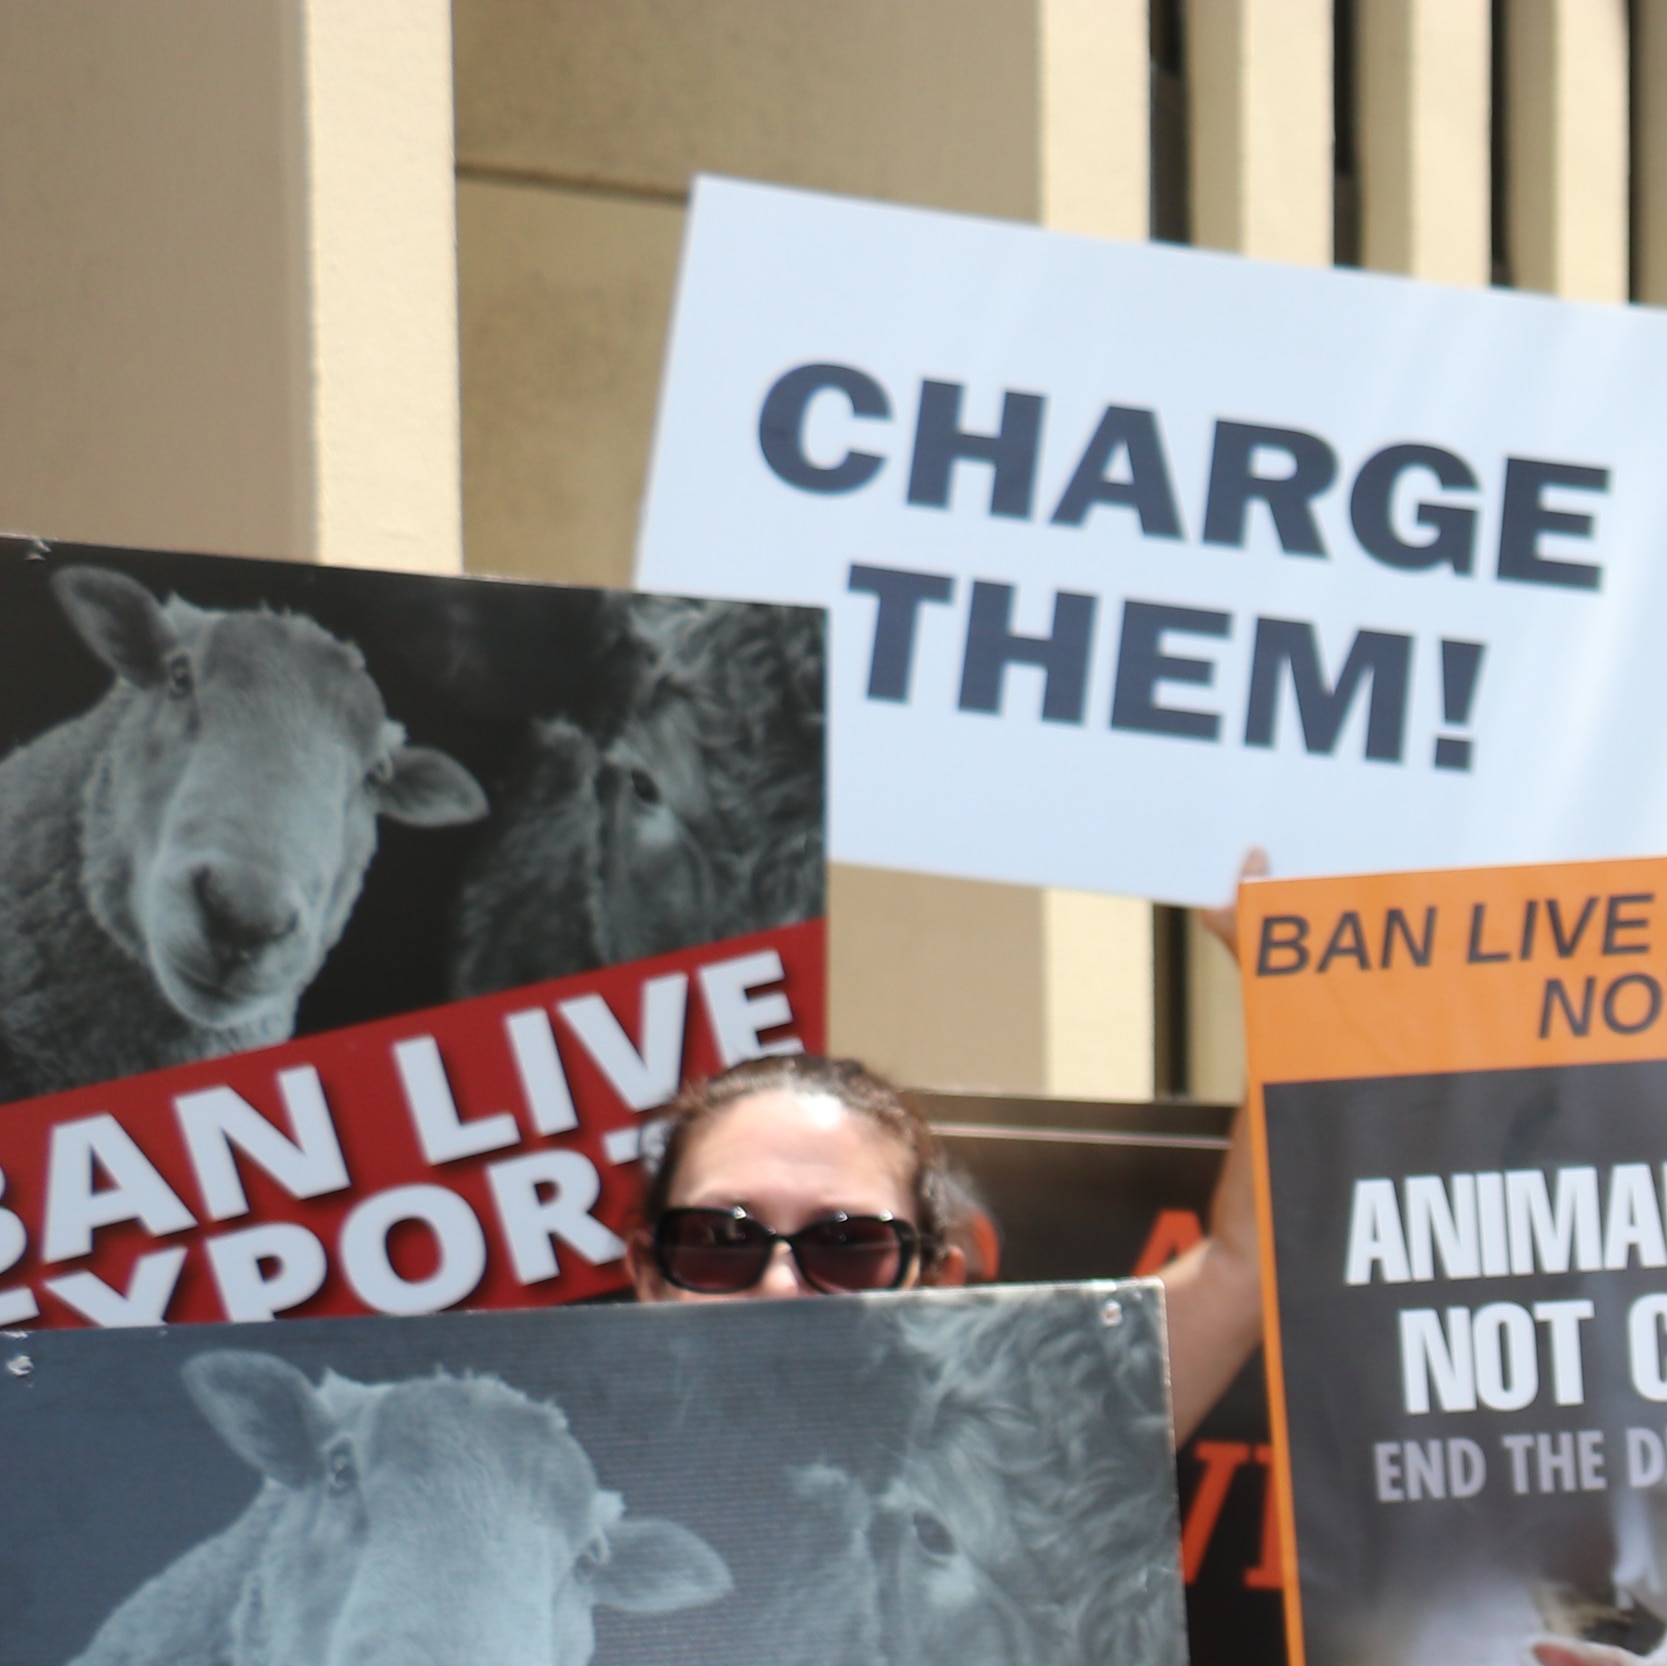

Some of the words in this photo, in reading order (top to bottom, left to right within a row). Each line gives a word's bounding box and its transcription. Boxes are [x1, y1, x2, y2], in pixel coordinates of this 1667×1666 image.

[757, 362, 1613, 593] CHARGE
[846, 562, 1486, 774] THEM!
[1255, 905, 1438, 977] BAN
[1465, 894, 1655, 965] LIVE
[393, 950, 806, 1166] LIVE
[1398, 1301, 1594, 1415] NOT
[1374, 1438, 1486, 1504] END
[1504, 1431, 1607, 1495] THE
